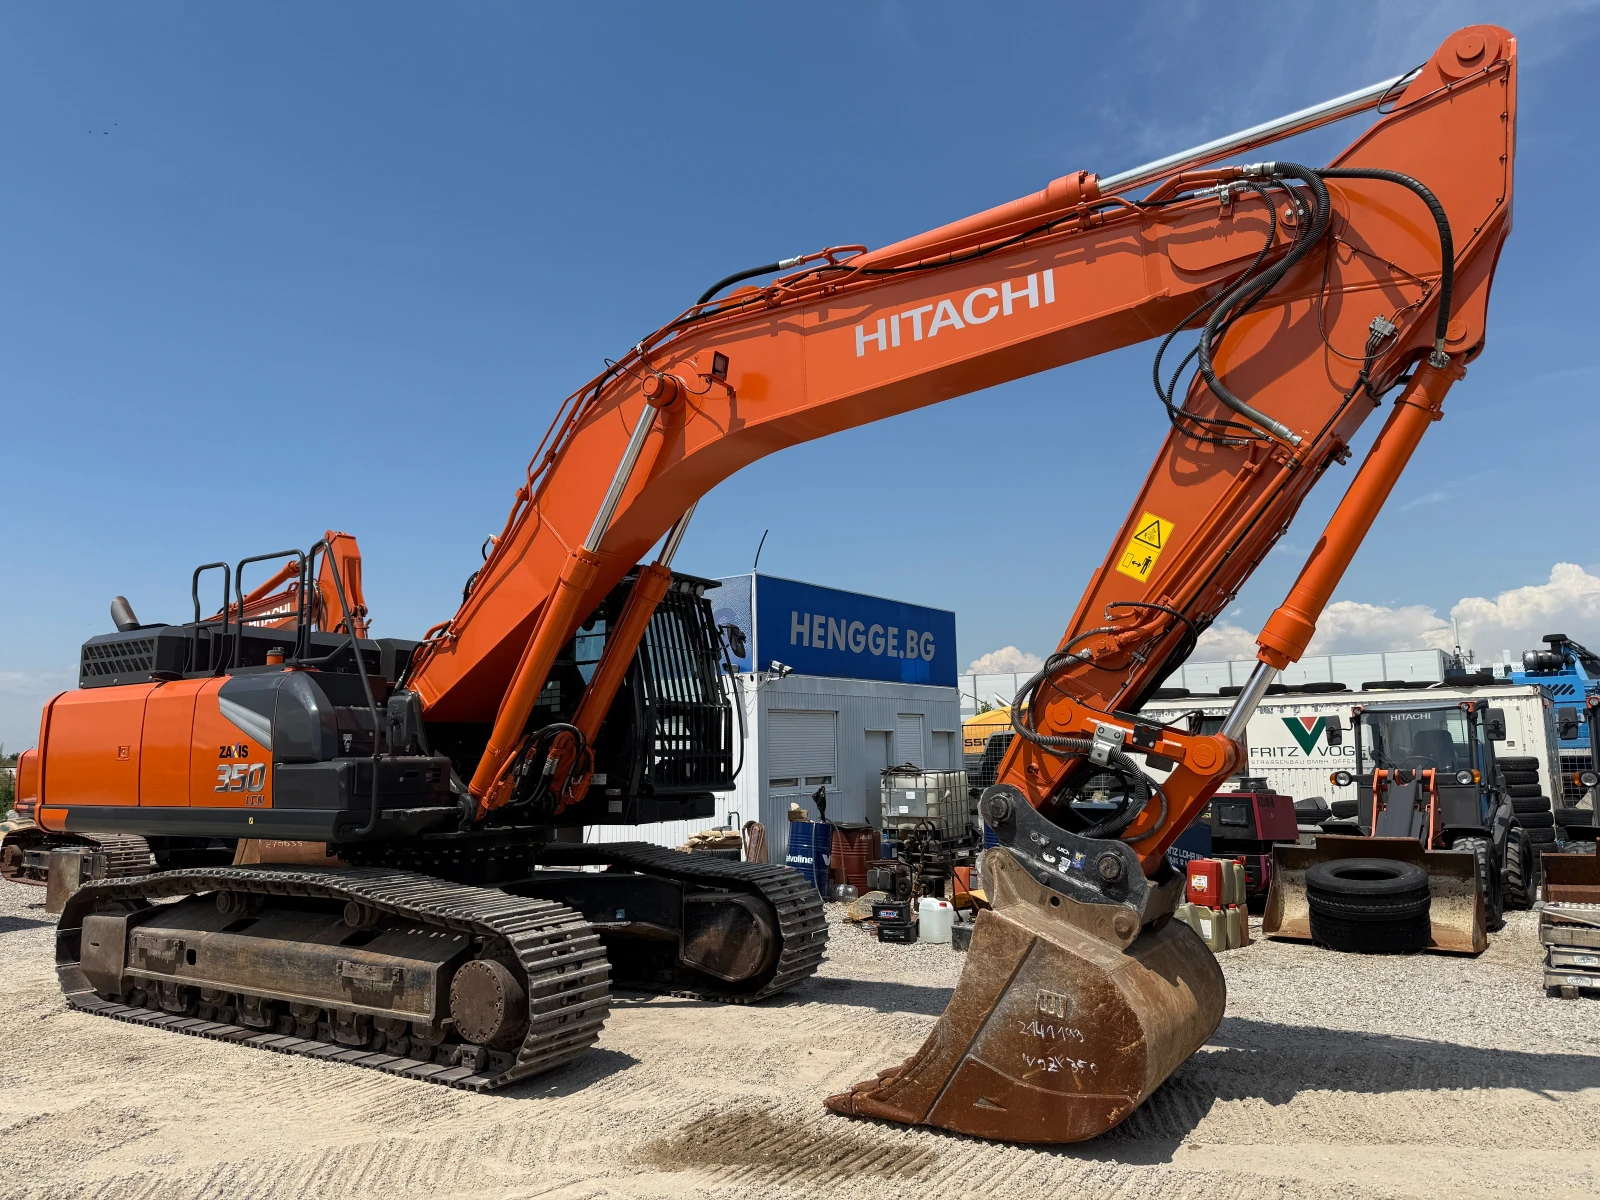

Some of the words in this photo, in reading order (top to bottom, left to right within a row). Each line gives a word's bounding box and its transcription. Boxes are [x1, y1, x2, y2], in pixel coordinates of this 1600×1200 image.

[855, 268, 1055, 358] HITACHI
[790, 611, 935, 662] HENGGE.BG
[1390, 712, 1431, 721] HITACHI
[218, 742, 249, 759] ZAXIS
[1250, 746, 1300, 757] FRITZ
[213, 763, 267, 793] 350
[245, 794, 265, 807] LCN
